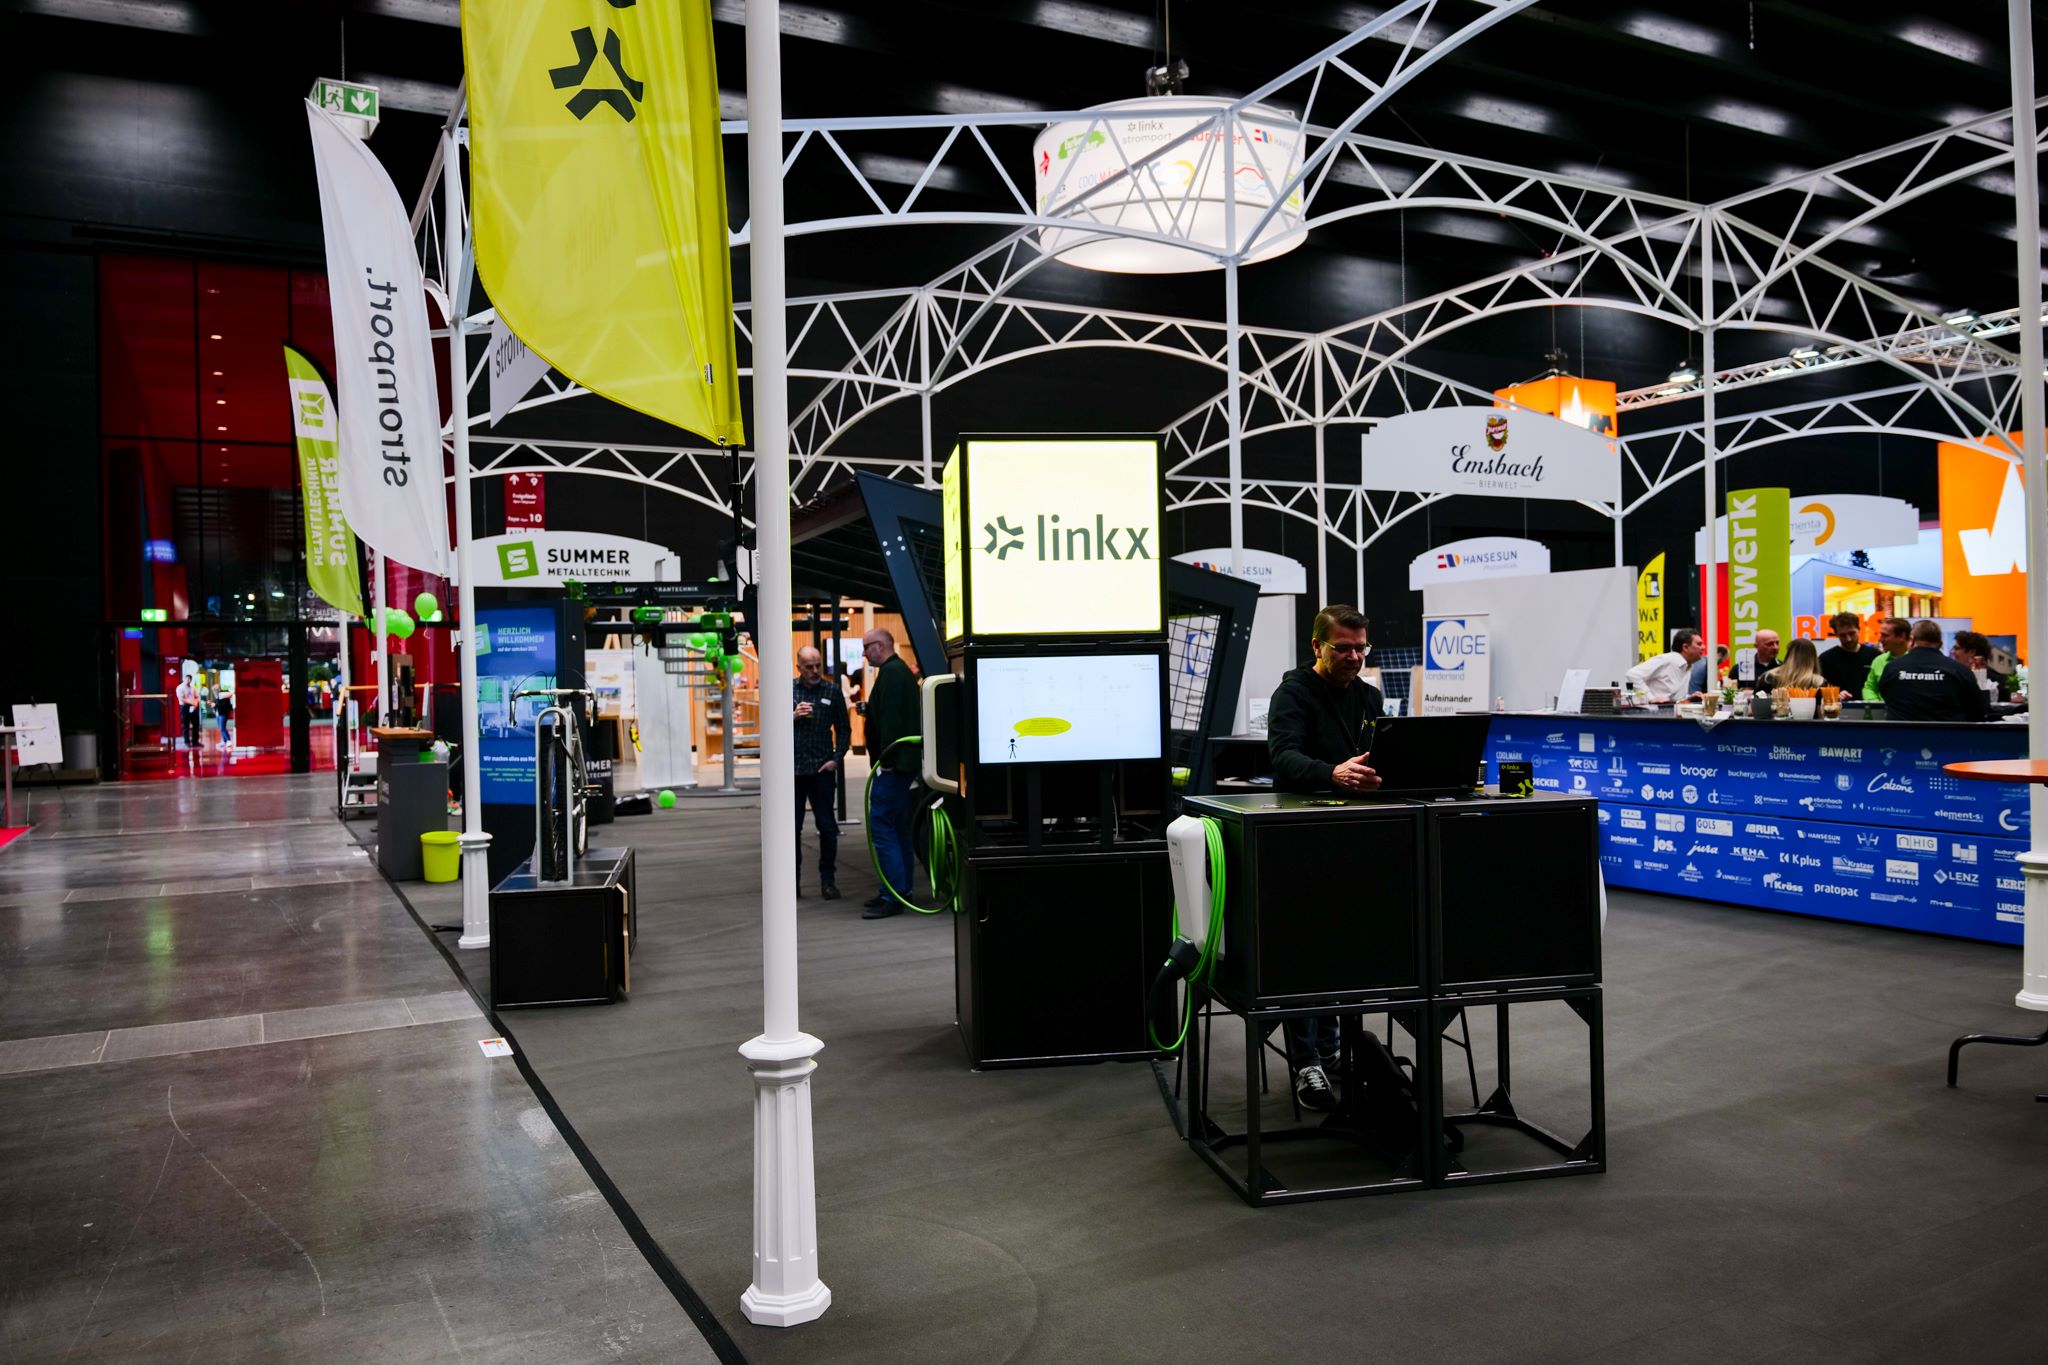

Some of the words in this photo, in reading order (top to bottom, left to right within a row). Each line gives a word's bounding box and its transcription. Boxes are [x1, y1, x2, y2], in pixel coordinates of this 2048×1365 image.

[1451, 444, 1545, 482] Emsbach
[530, 477, 538, 486] 9
[1478, 480, 1518, 490] BIERWELT
[529, 513, 542, 522] 10
[1037, 513, 1151, 561] linkx
[547, 548, 630, 564] SUMMER
[1463, 550, 1518, 564] HANSESUN
[548, 568, 631, 577] METALLTECHNIK
[498, 626, 531, 635] HERZLICH
[498, 635, 544, 644] WILLKOMMEN
[1434, 635, 1486, 655] WIGE
[1424, 672, 1465, 680] Vorderland
[1424, 694, 1472, 703] Aufeinander
[1773, 744, 1790, 753] bau
[1821, 747, 1863, 758] BAWART
[1768, 752, 1806, 761] summer
[1680, 763, 1718, 779] broger
[1867, 772, 1915, 794] Calzone
[1656, 788, 1674, 800] dpd
[1808, 832, 1841, 841] HANSESUN
[1913, 838, 1934, 849] HIG
[1949, 872, 1979, 883] LENZ
[1774, 880, 1803, 892] Kröss
[1814, 883, 1859, 897] pratopac
